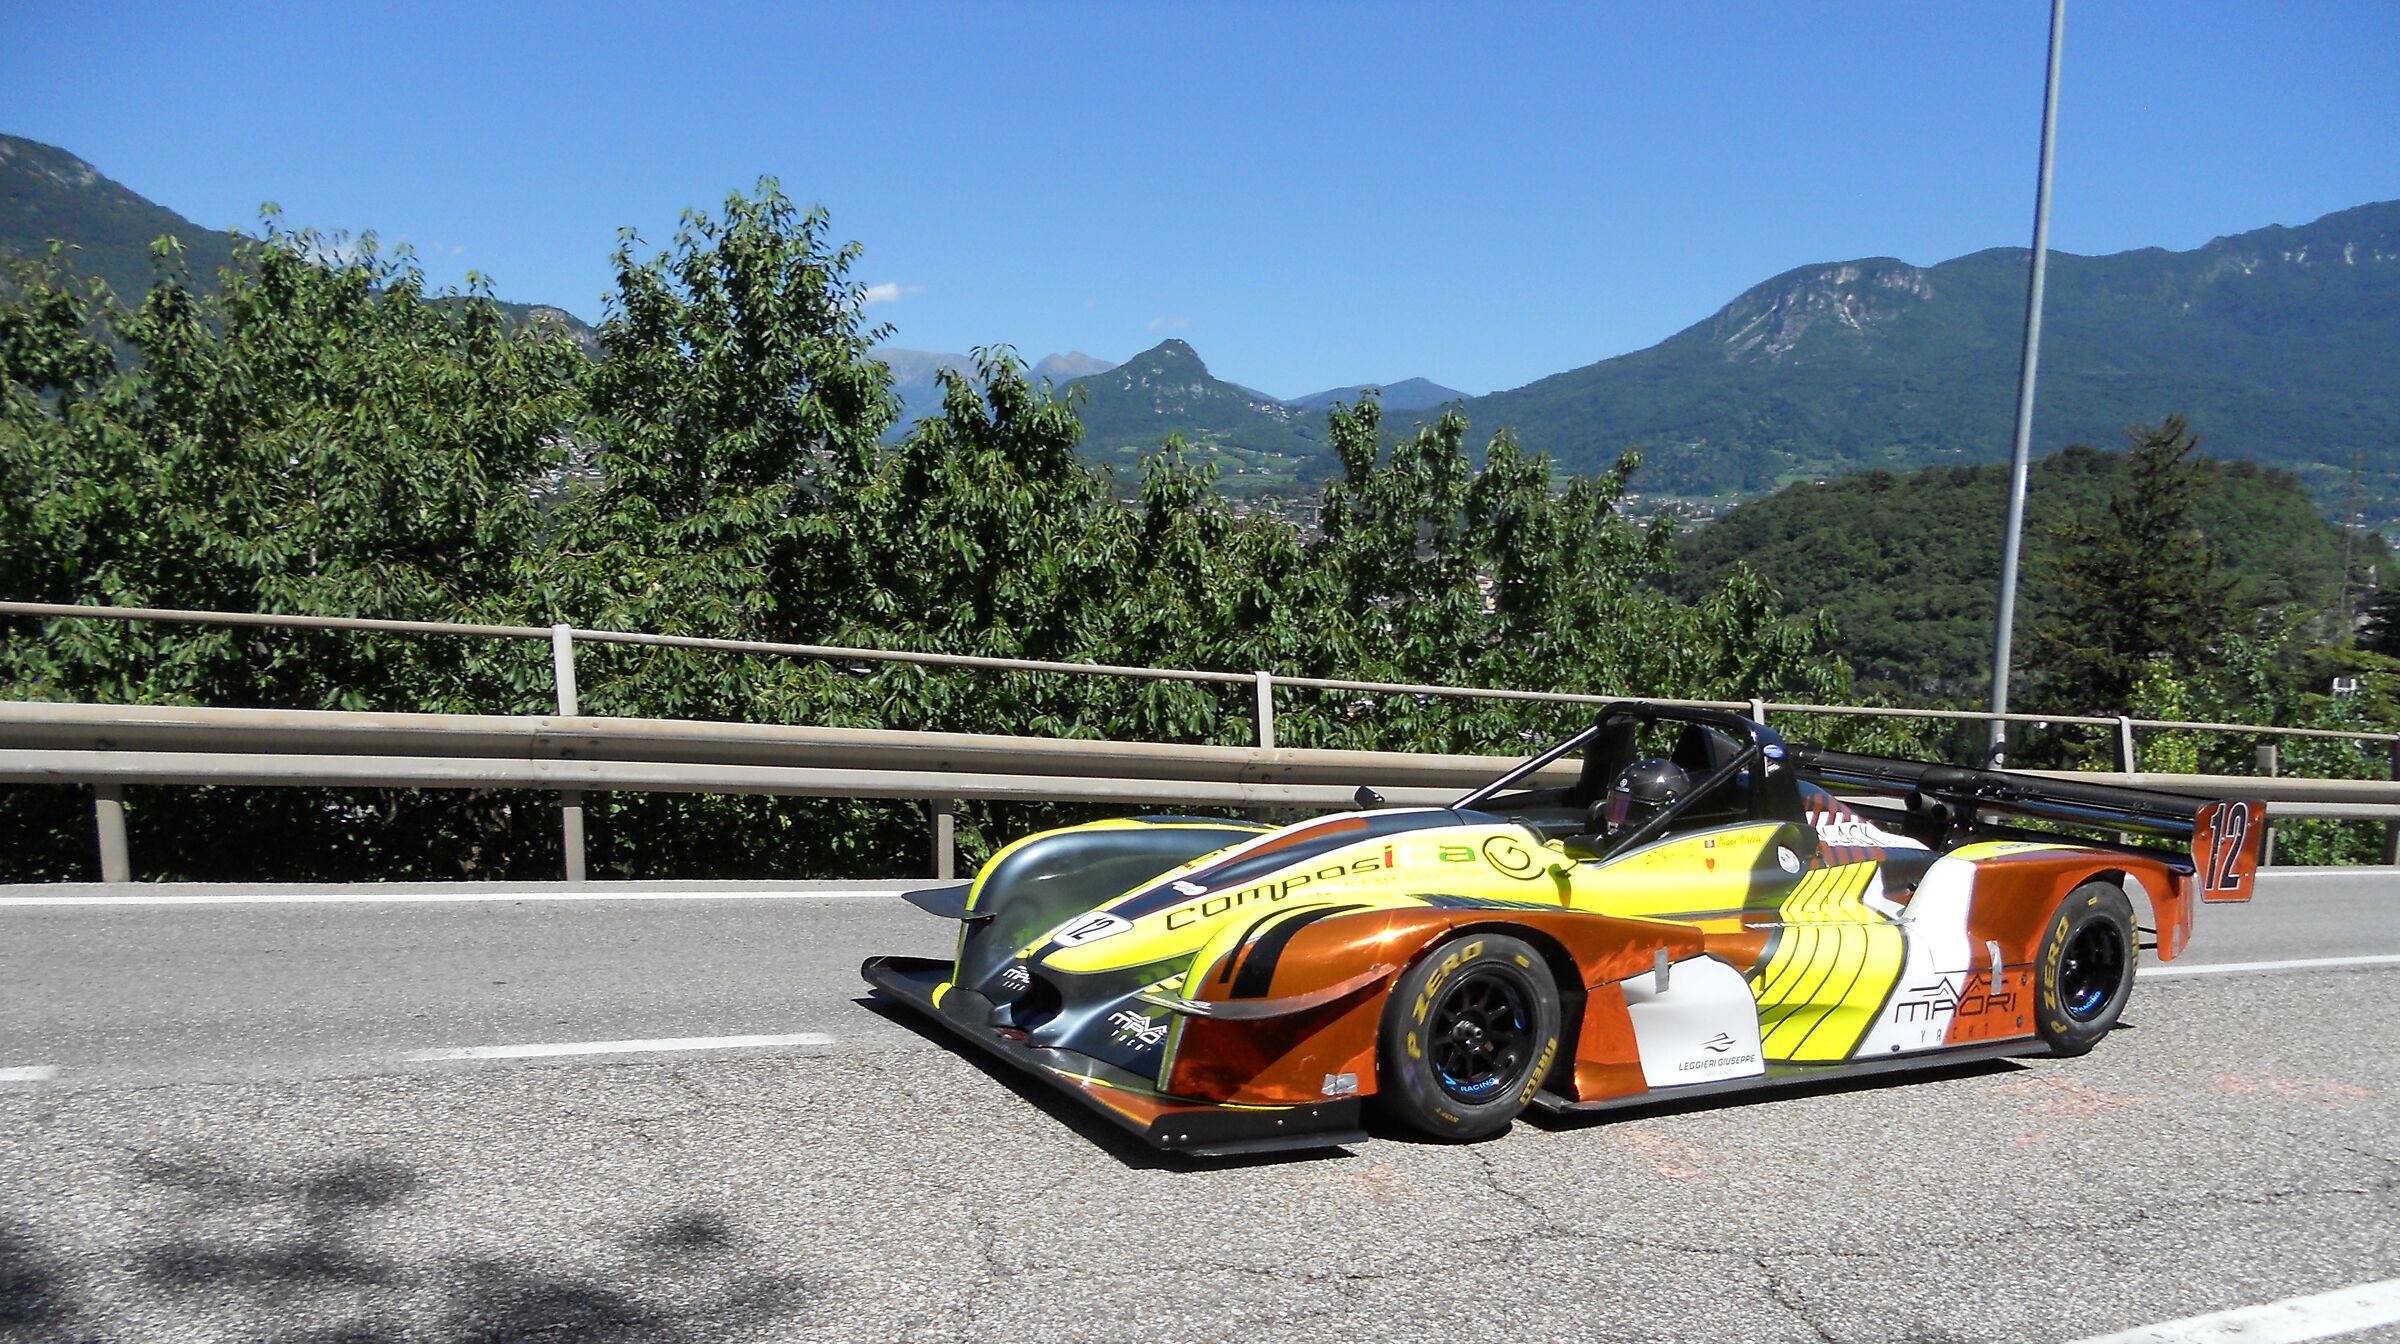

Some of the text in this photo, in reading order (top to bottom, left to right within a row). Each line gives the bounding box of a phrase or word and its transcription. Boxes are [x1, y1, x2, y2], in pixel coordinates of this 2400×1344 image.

[2204, 801, 2248, 891] 12
[1066, 916, 1116, 941] 12
[1407, 940, 1485, 1060] P ZERO
[2043, 914, 2070, 1034] P ZERO
[1678, 1054, 1756, 1072] LEGGIERI GIUSEPPE
